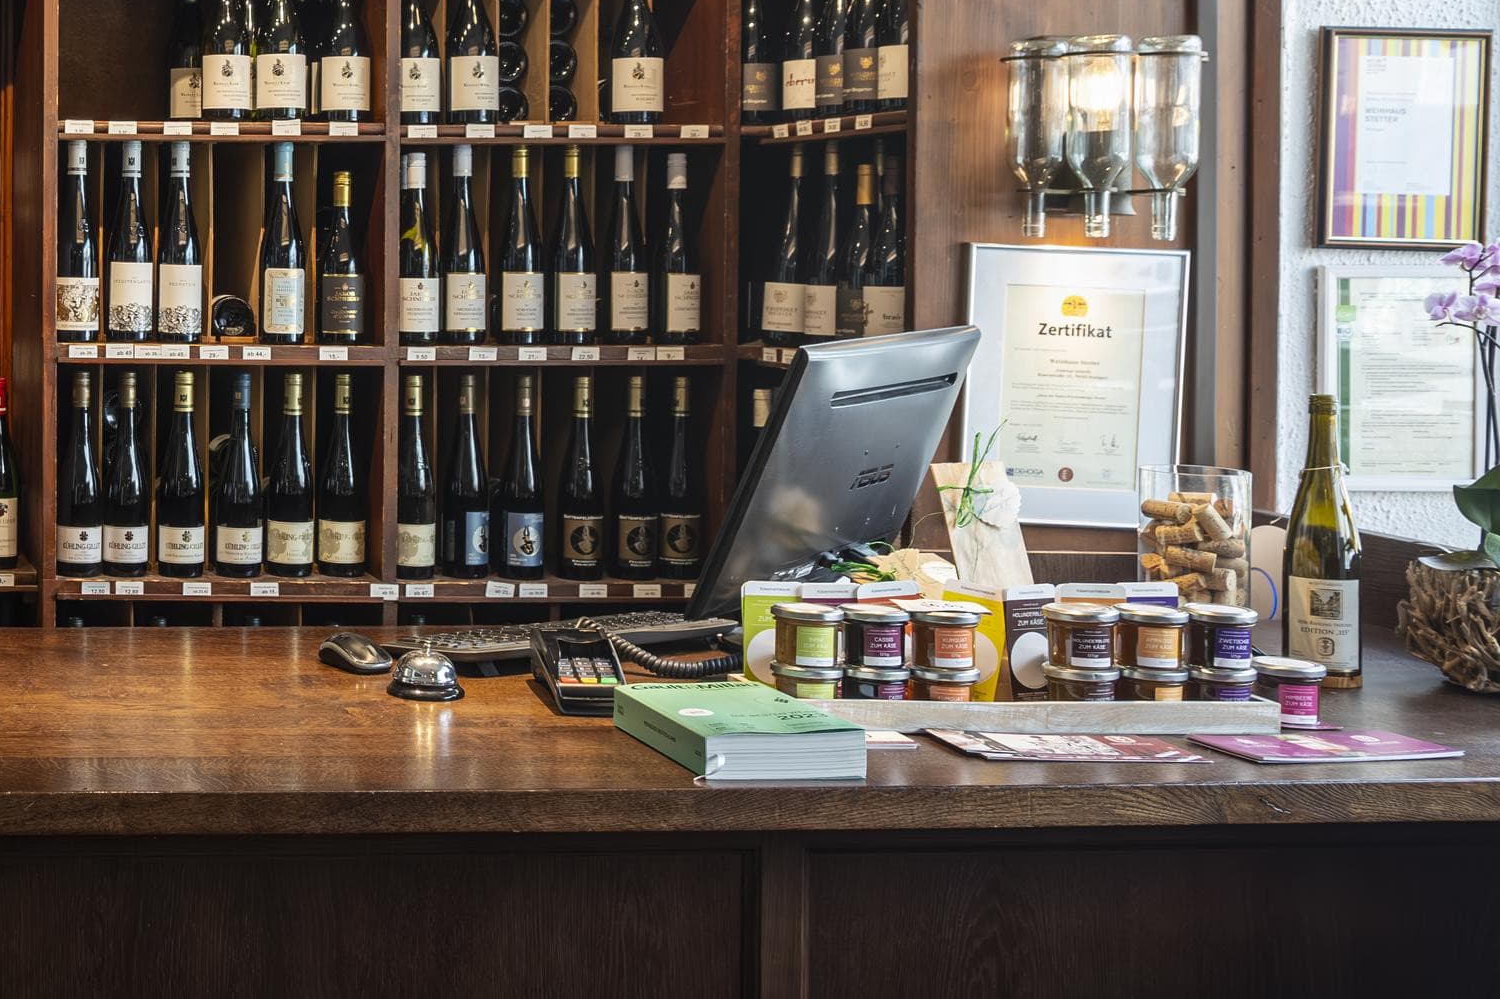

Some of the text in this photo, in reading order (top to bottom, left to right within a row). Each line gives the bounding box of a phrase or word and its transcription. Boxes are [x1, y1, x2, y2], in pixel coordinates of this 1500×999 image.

[1037, 322, 1112, 338] Zertifikat
[1014, 466, 1044, 475] DEHOGA
[1017, 617, 1044, 627] ZUM KÄSE
[1301, 626, 1334, 636] EDITION
[1093, 642, 1106, 650] KÄSE
[1235, 643, 1248, 651] KÄSE
